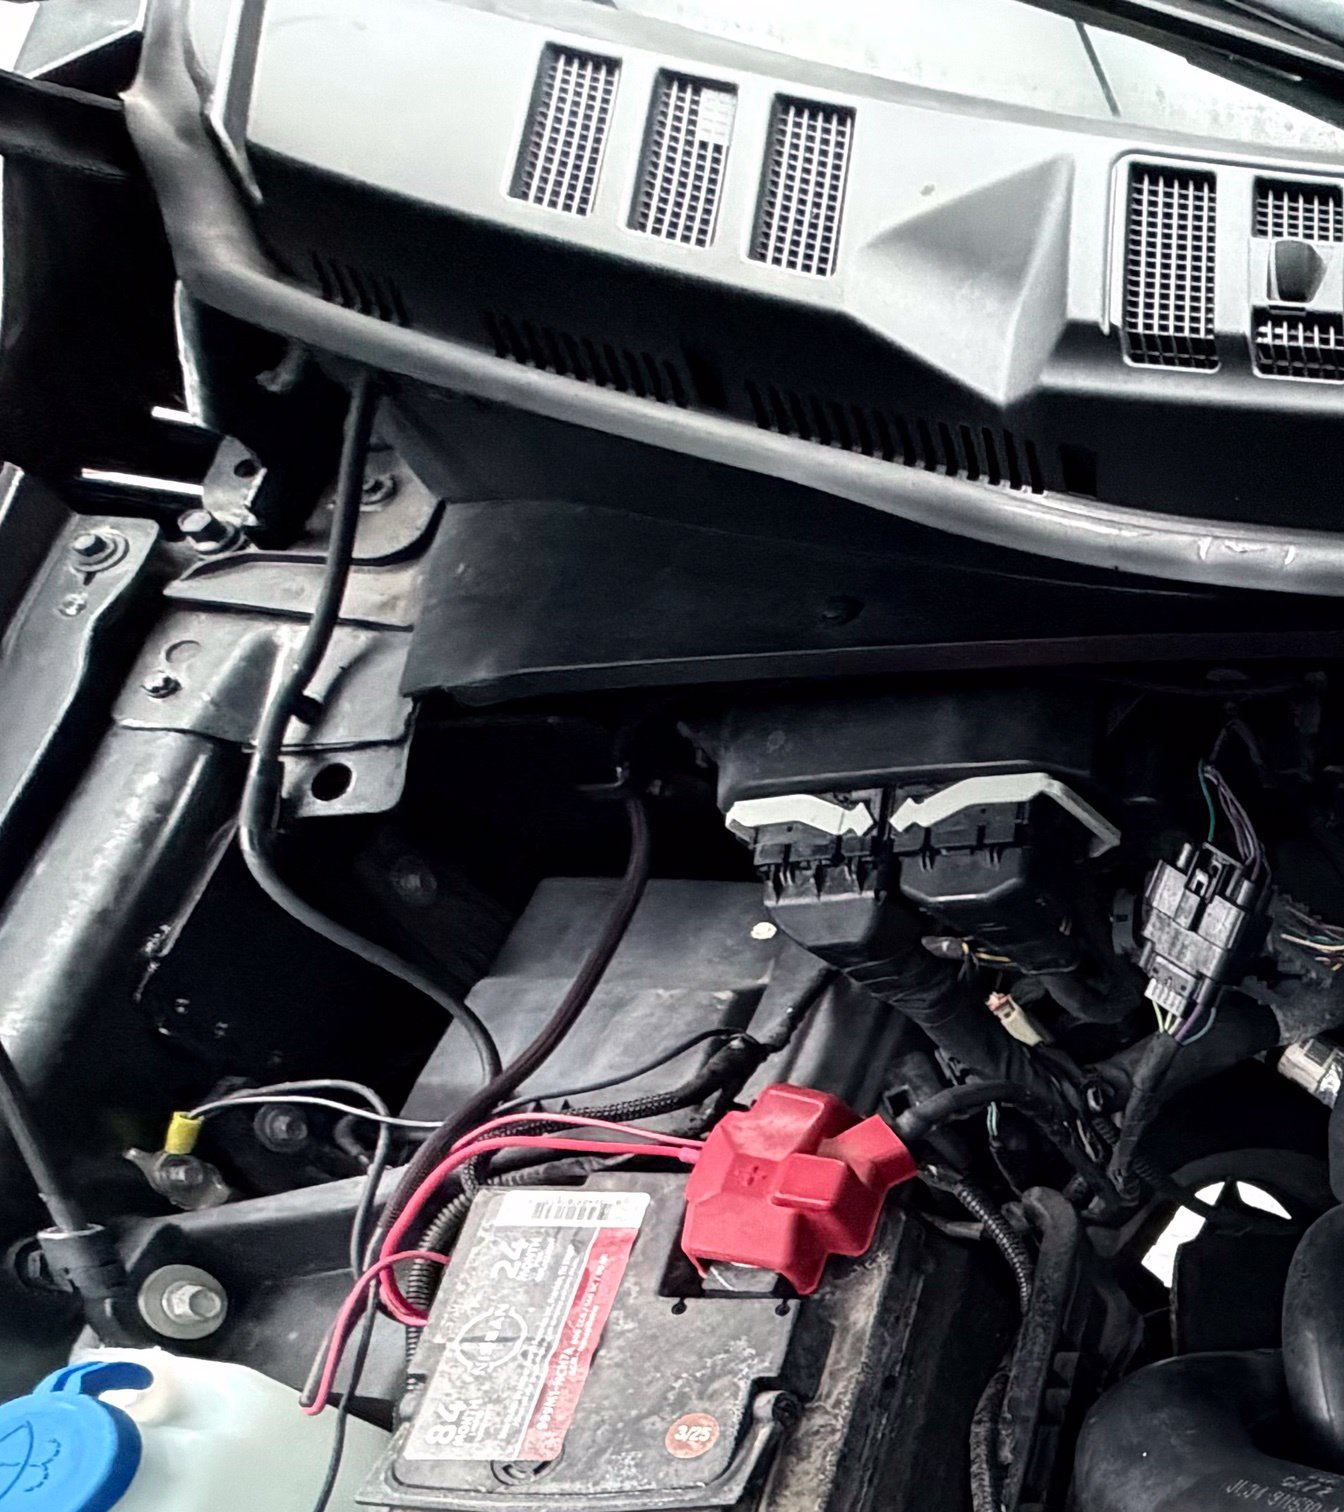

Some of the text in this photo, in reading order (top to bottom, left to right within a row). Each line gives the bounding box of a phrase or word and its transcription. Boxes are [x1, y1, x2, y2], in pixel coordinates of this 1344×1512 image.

[491, 1240, 529, 1281] 24
[424, 1399, 465, 1447] 84
[453, 1400, 478, 1446] MONTH
[674, 1424, 712, 1442] 3/25
